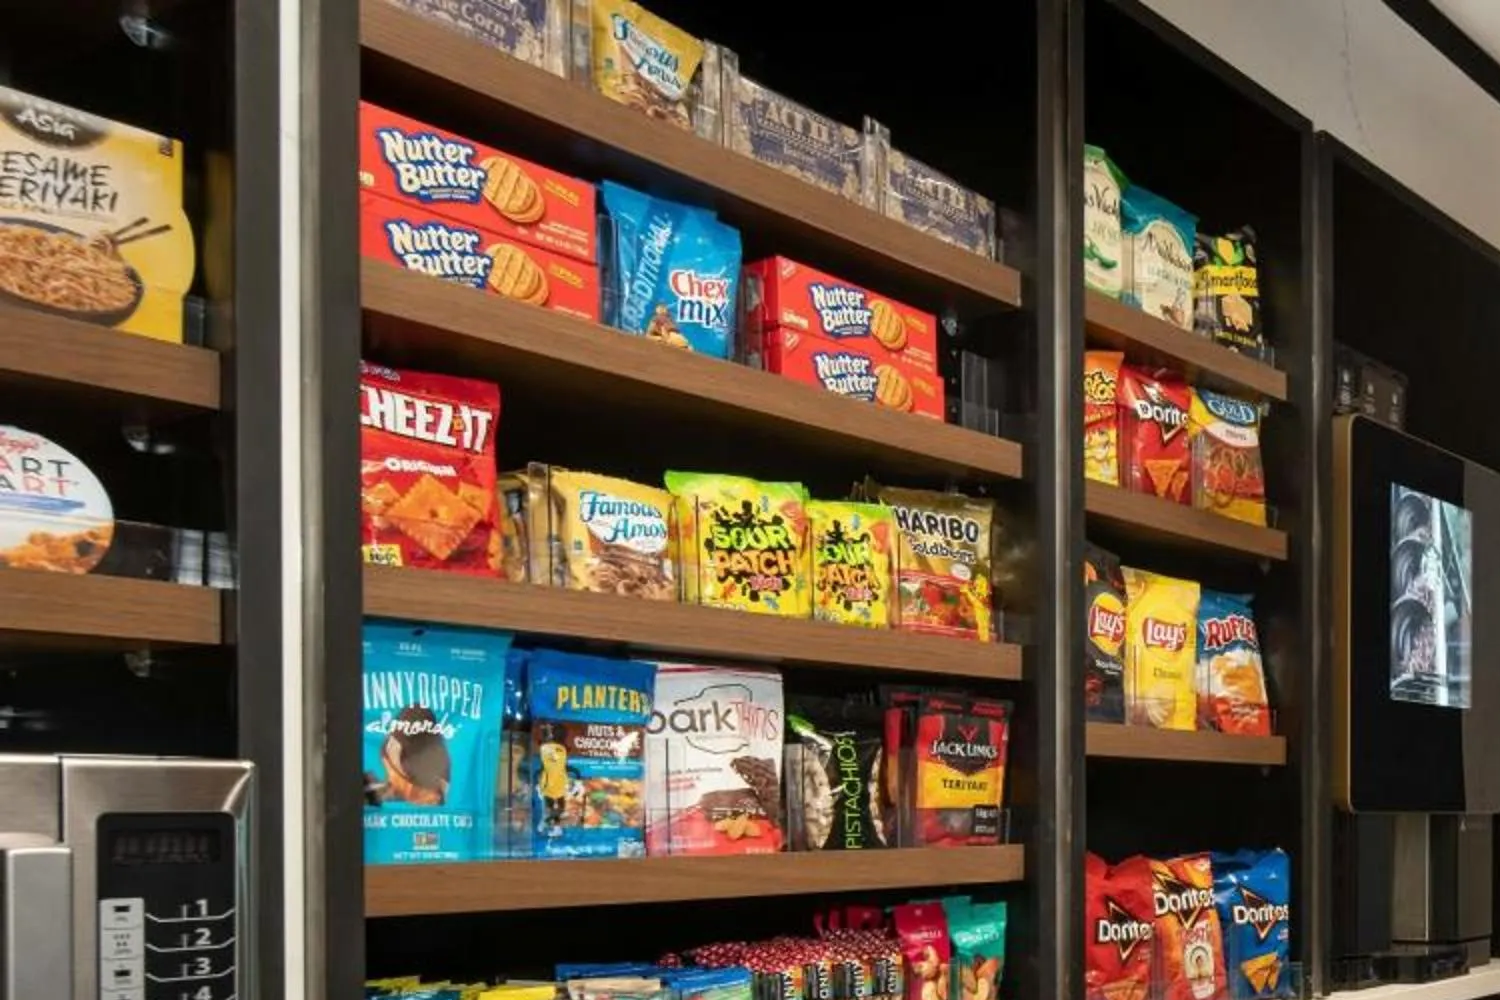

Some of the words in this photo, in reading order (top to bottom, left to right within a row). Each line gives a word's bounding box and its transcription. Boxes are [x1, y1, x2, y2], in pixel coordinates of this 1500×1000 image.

[378, 131, 474, 165] Nutter
[396, 161, 485, 193] Butter
[387, 221, 479, 254] Nutter
[670, 270, 728, 300] Chex
[811, 285, 864, 310] Nutter
[822, 307, 872, 333] Butter
[815, 354, 869, 379] Nutter
[580, 490, 663, 520] Famous
[603, 519, 668, 543] Amos
[714, 525, 789, 551] SOUR
[894, 507, 980, 543] HARIBO
[715, 550, 798, 577] PATCH
[1145, 618, 1187, 648] Lay's
[366, 711, 459, 740] almonds
[196, 899, 209, 917] 1
[1154, 888, 1215, 915] Doritos
[1233, 904, 1288, 925] Doritos
[194, 927, 212, 946] 2
[194, 956, 212, 977] 3
